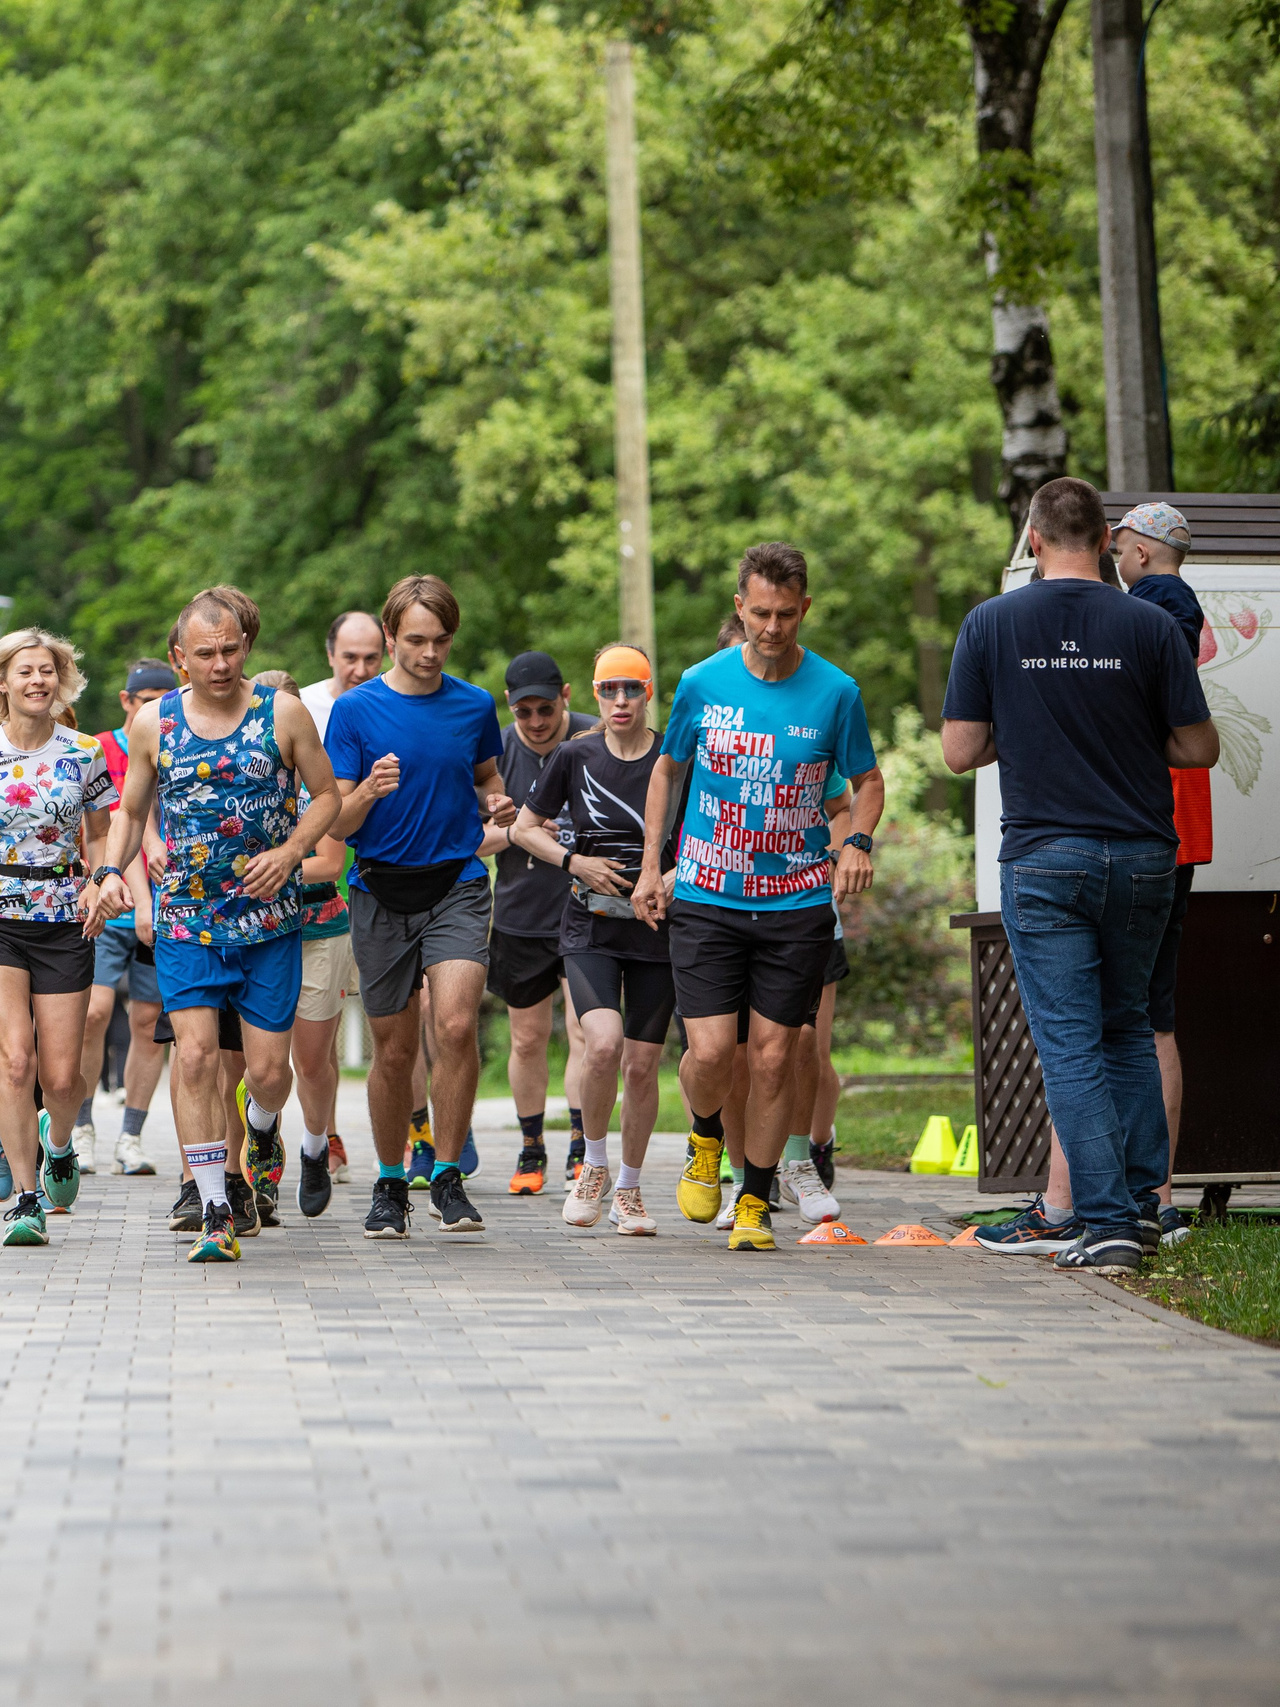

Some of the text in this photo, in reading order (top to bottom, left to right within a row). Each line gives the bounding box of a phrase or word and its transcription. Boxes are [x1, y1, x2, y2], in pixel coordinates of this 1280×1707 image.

[1021, 658, 1122, 669] ЭТО НЕ КО МНЕ
[701, 704, 745, 730] 2024
[705, 728, 774, 758] #МЕЧТА
[699, 790, 747, 828] #ЗАБЕГ
[712, 820, 806, 854] #ГОРДОСТЬ
[682, 834, 755, 875] #ЛЮБОВЬ
[187, 1154, 208, 1163] RUN
